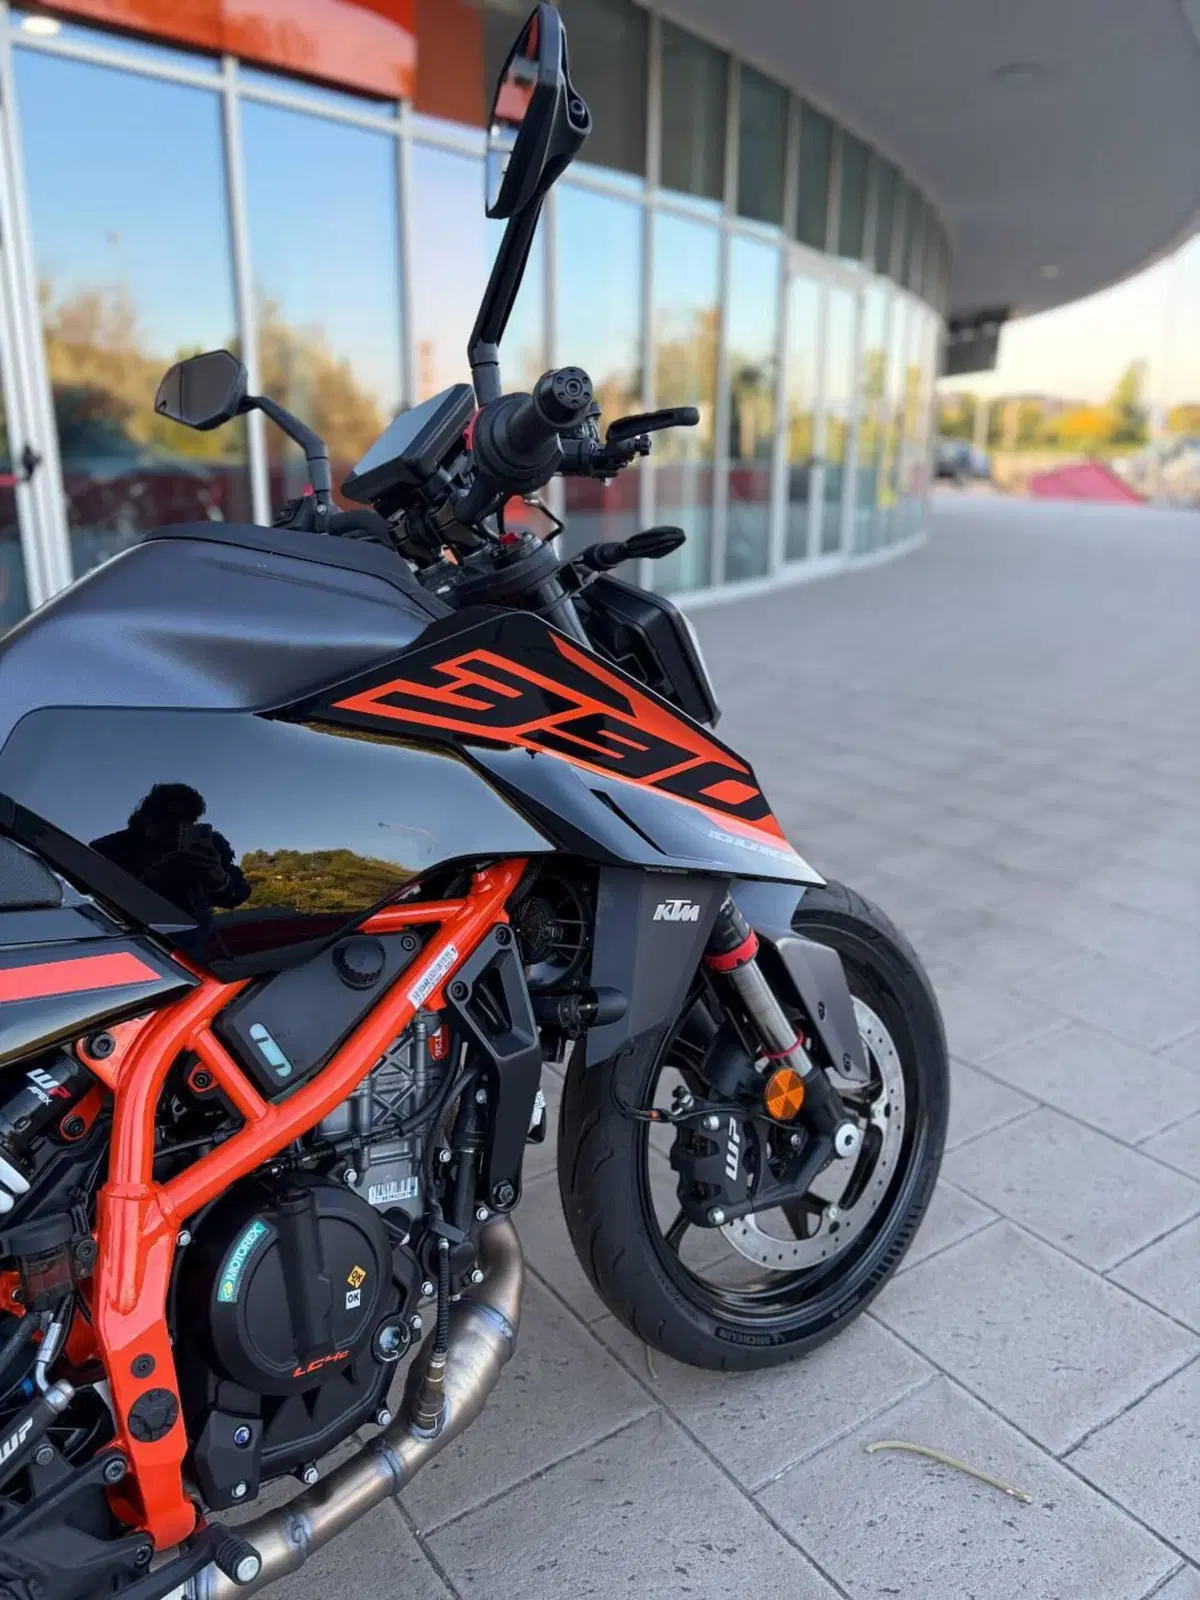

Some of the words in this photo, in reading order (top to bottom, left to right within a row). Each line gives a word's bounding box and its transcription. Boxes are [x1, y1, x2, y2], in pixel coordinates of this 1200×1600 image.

[653, 900, 700, 922] KTM
[26, 1068, 71, 1099] WP
[27, 1086, 53, 1106] APEX
[725, 1116, 740, 1181] WP
[225, 1224, 263, 1281] MOTOREX
[352, 1270, 364, 1282] OK
[347, 1292, 360, 1303] OK
[0, 1416, 33, 1466] WP
